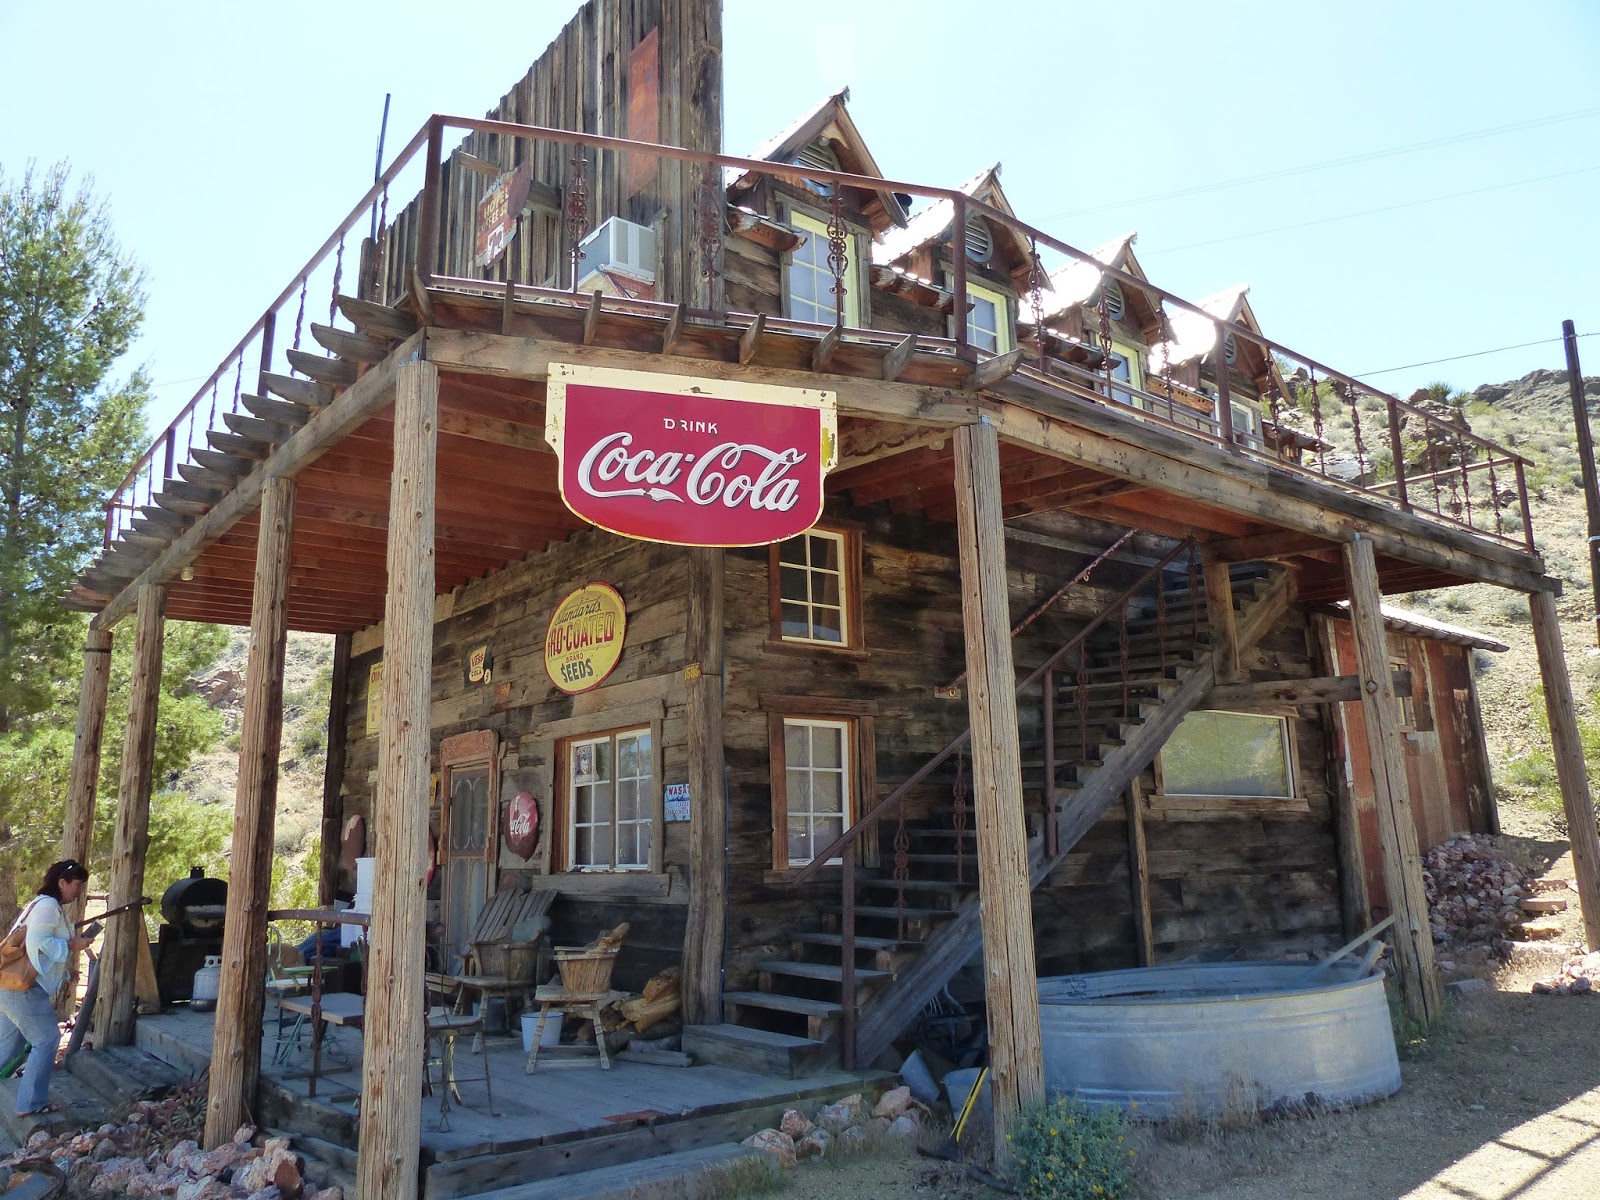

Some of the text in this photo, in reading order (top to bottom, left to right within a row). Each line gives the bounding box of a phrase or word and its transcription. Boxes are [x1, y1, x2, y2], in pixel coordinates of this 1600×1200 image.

[484, 187, 509, 219] HOTEL
[663, 418, 718, 434] DRINK
[577, 431, 807, 512] Coca-Cola
[471, 653, 484, 667] VESS
[566, 653, 584, 664] BRAND
[471, 669, 483, 677] COLA
